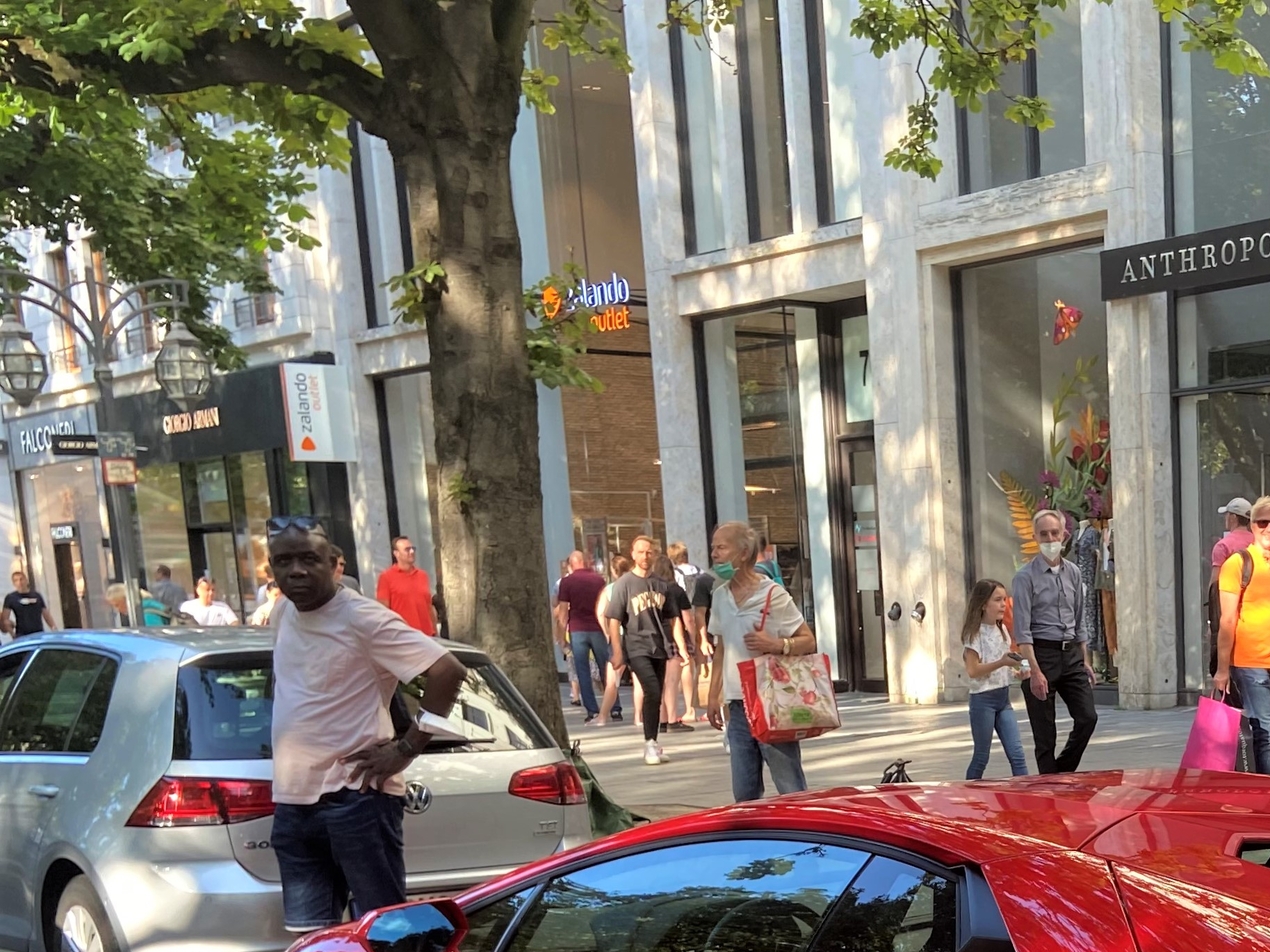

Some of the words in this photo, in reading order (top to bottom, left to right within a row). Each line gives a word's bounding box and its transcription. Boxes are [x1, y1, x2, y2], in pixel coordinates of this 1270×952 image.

[859, 350, 869, 387] 7
[294, 372, 313, 433] zalando
[308, 375, 321, 411] outlet
